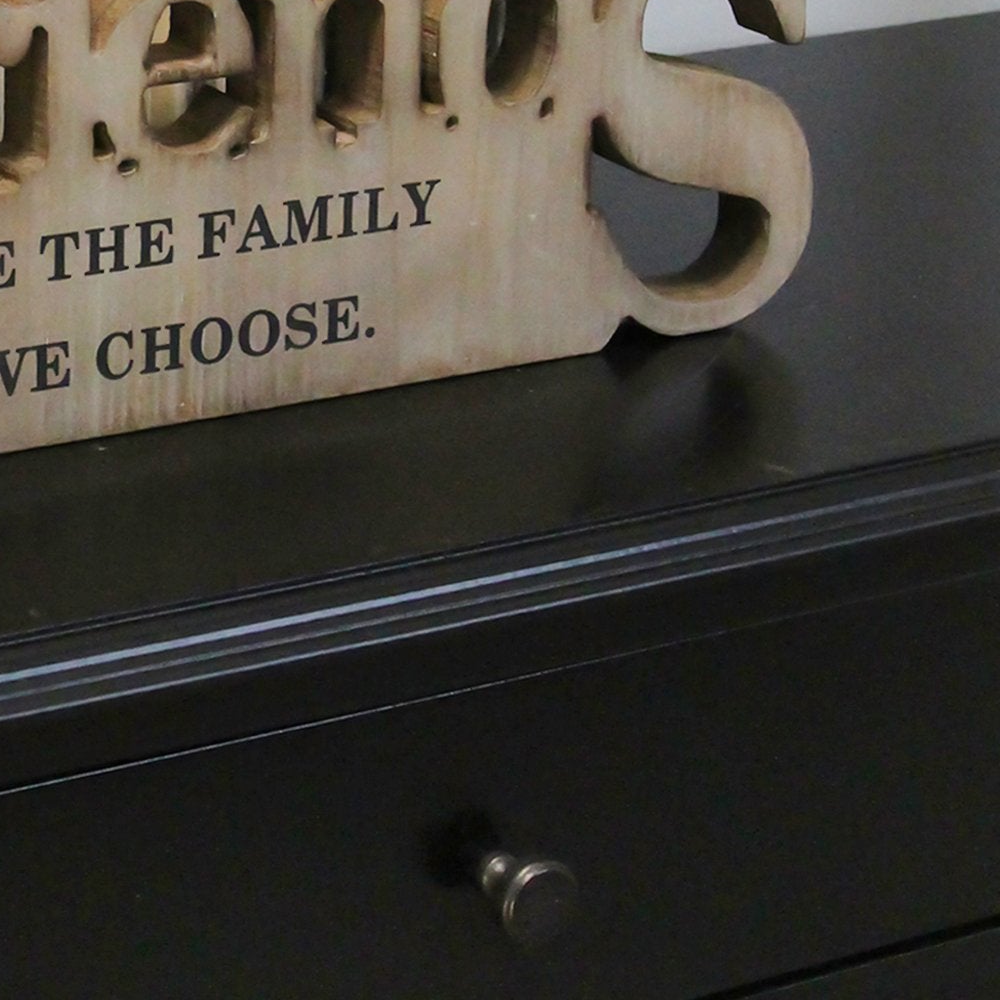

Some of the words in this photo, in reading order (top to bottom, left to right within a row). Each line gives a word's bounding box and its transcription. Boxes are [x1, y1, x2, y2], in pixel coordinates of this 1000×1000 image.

[39, 217, 174, 282] THE
[197, 179, 441, 260] FAMILY
[95, 295, 376, 381] CHOOSE.
